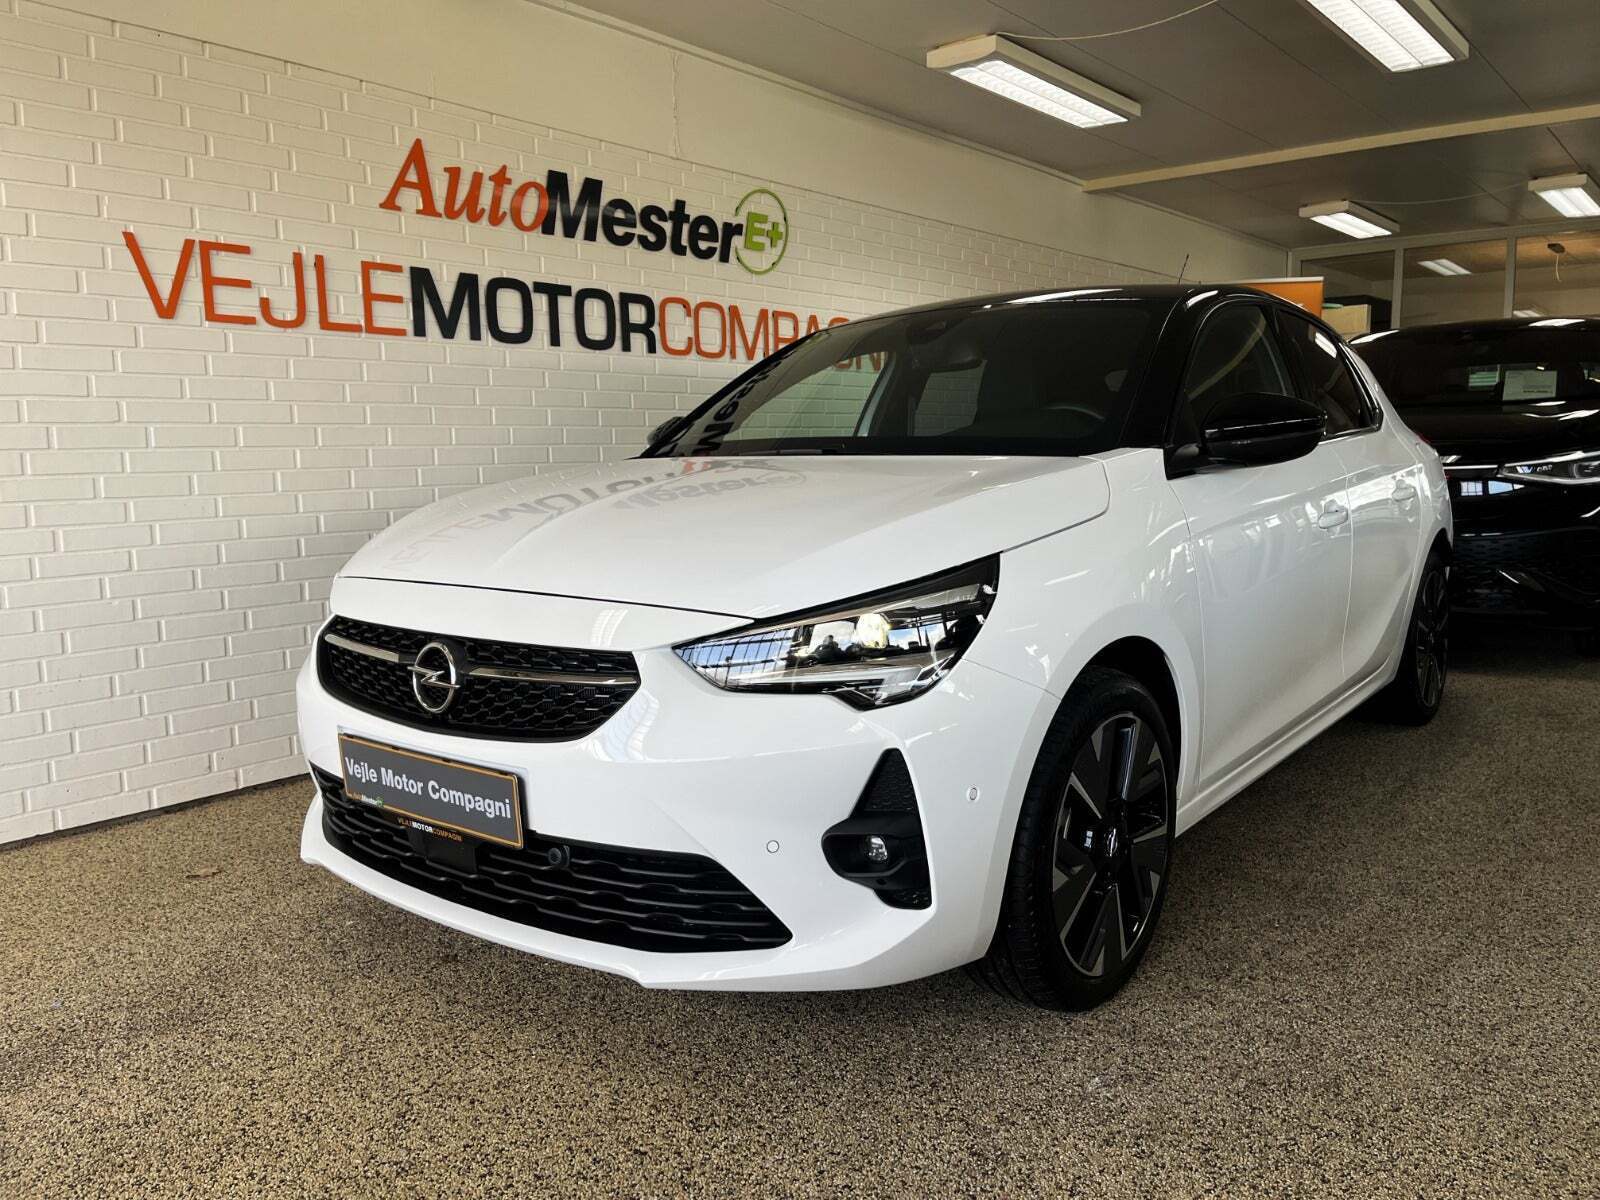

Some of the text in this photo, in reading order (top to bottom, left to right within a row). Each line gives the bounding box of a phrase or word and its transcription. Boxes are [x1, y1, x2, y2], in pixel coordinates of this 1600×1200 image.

[345, 757, 511, 818] Vejle Motor Compagni
